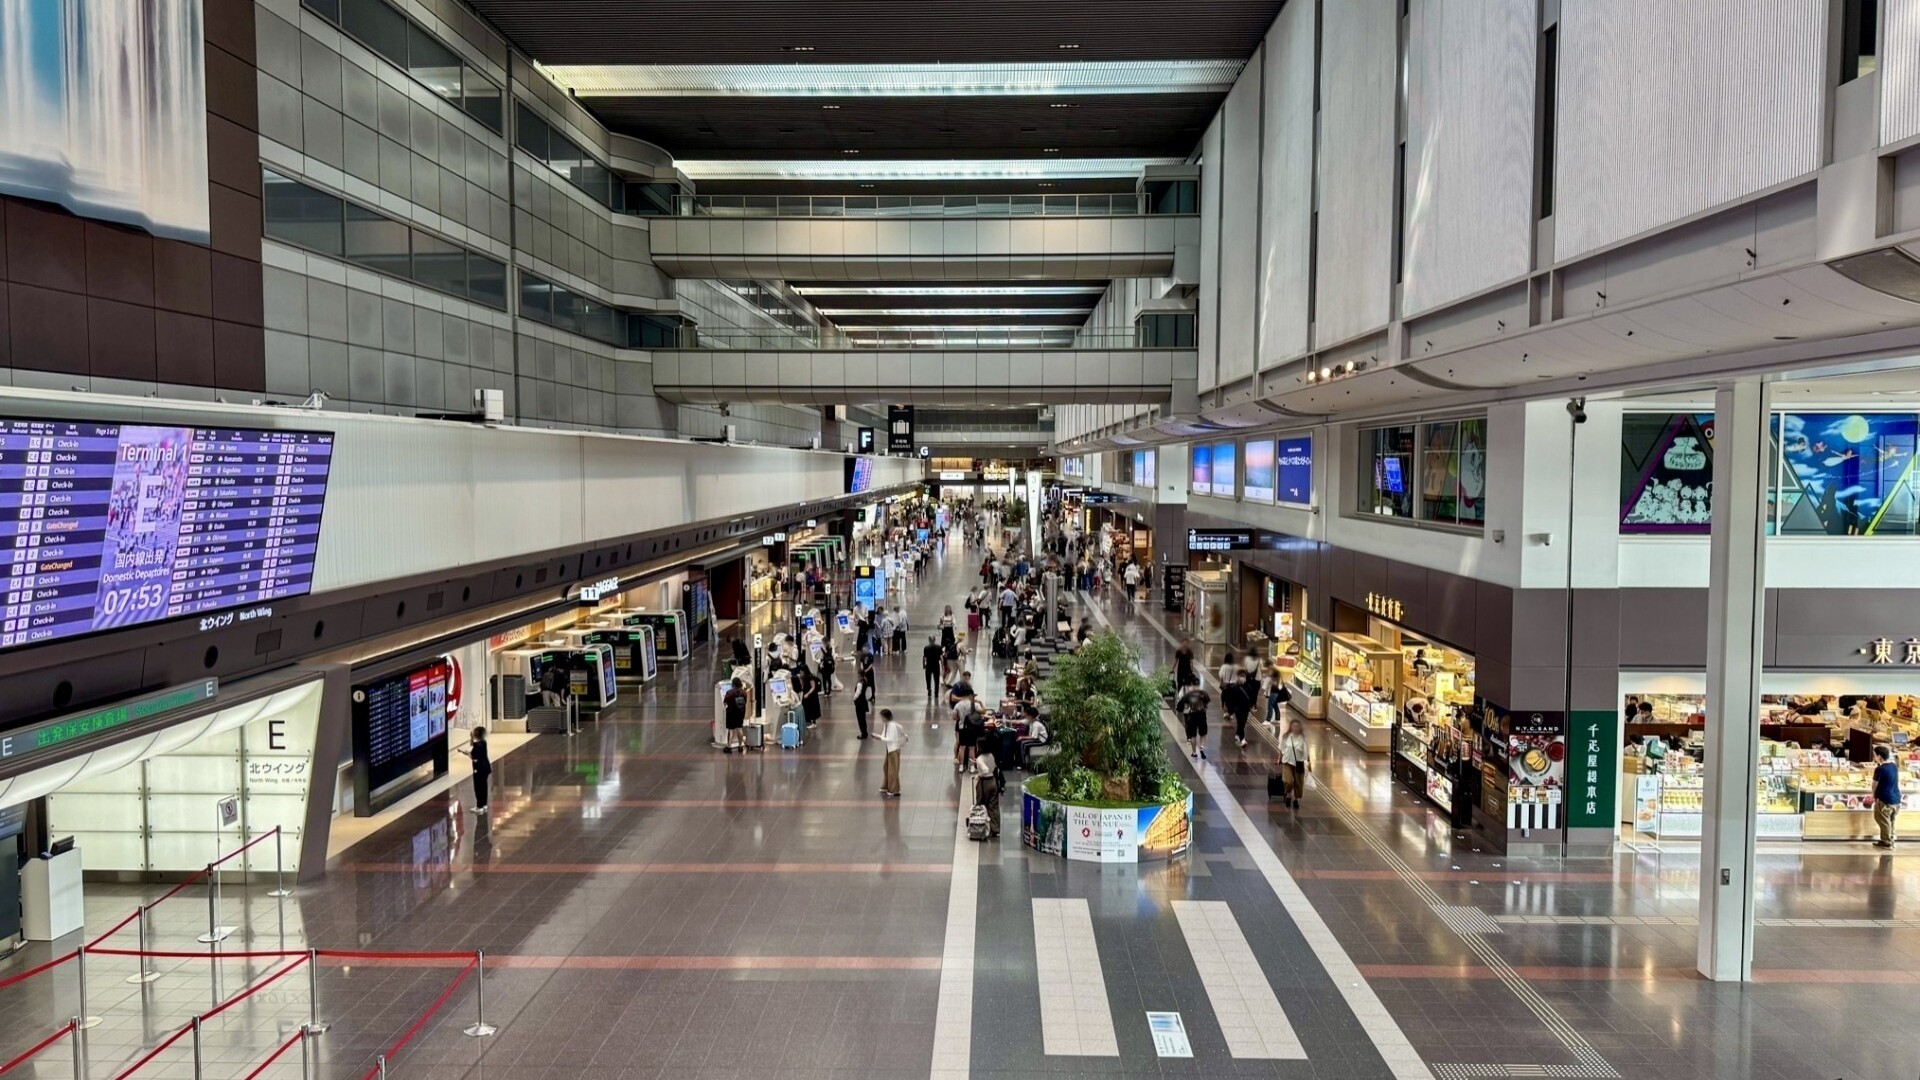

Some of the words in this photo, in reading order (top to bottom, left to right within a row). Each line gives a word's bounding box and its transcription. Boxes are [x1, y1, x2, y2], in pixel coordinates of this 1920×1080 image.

[862, 432, 871, 448] F
[121, 442, 177, 462] Terminal
[182, 444, 187, 461] 1
[921, 446, 928, 456] G
[134, 474, 163, 532] E
[46, 521, 78, 530] GateChanged
[44, 536, 65, 544] Check-in
[43, 549, 63, 557] Check-in
[115, 552, 164, 568] 国内線出発
[41, 561, 72, 571] GateChanged
[103, 571, 134, 584] Domestic
[136, 566, 170, 580] Departures
[39, 576, 59, 585] Check-in
[37, 589, 58, 598] Check-in
[585, 589, 596, 598] 11
[104, 583, 162, 615] 07:53
[35, 603, 56, 612] Check-in
[240, 608, 256, 621] North
[257, 606, 272, 618] Wing
[33, 617, 54, 626] Check-in
[200, 612, 233, 630] 北ウイング
[31, 631, 52, 639] Check-in
[206, 682, 213, 697] E
[269, 720, 286, 750] E
[2, 737, 12, 756] E
[250, 763, 305, 774] 北ウイング
[1100, 812, 1122, 820] JAPAN
